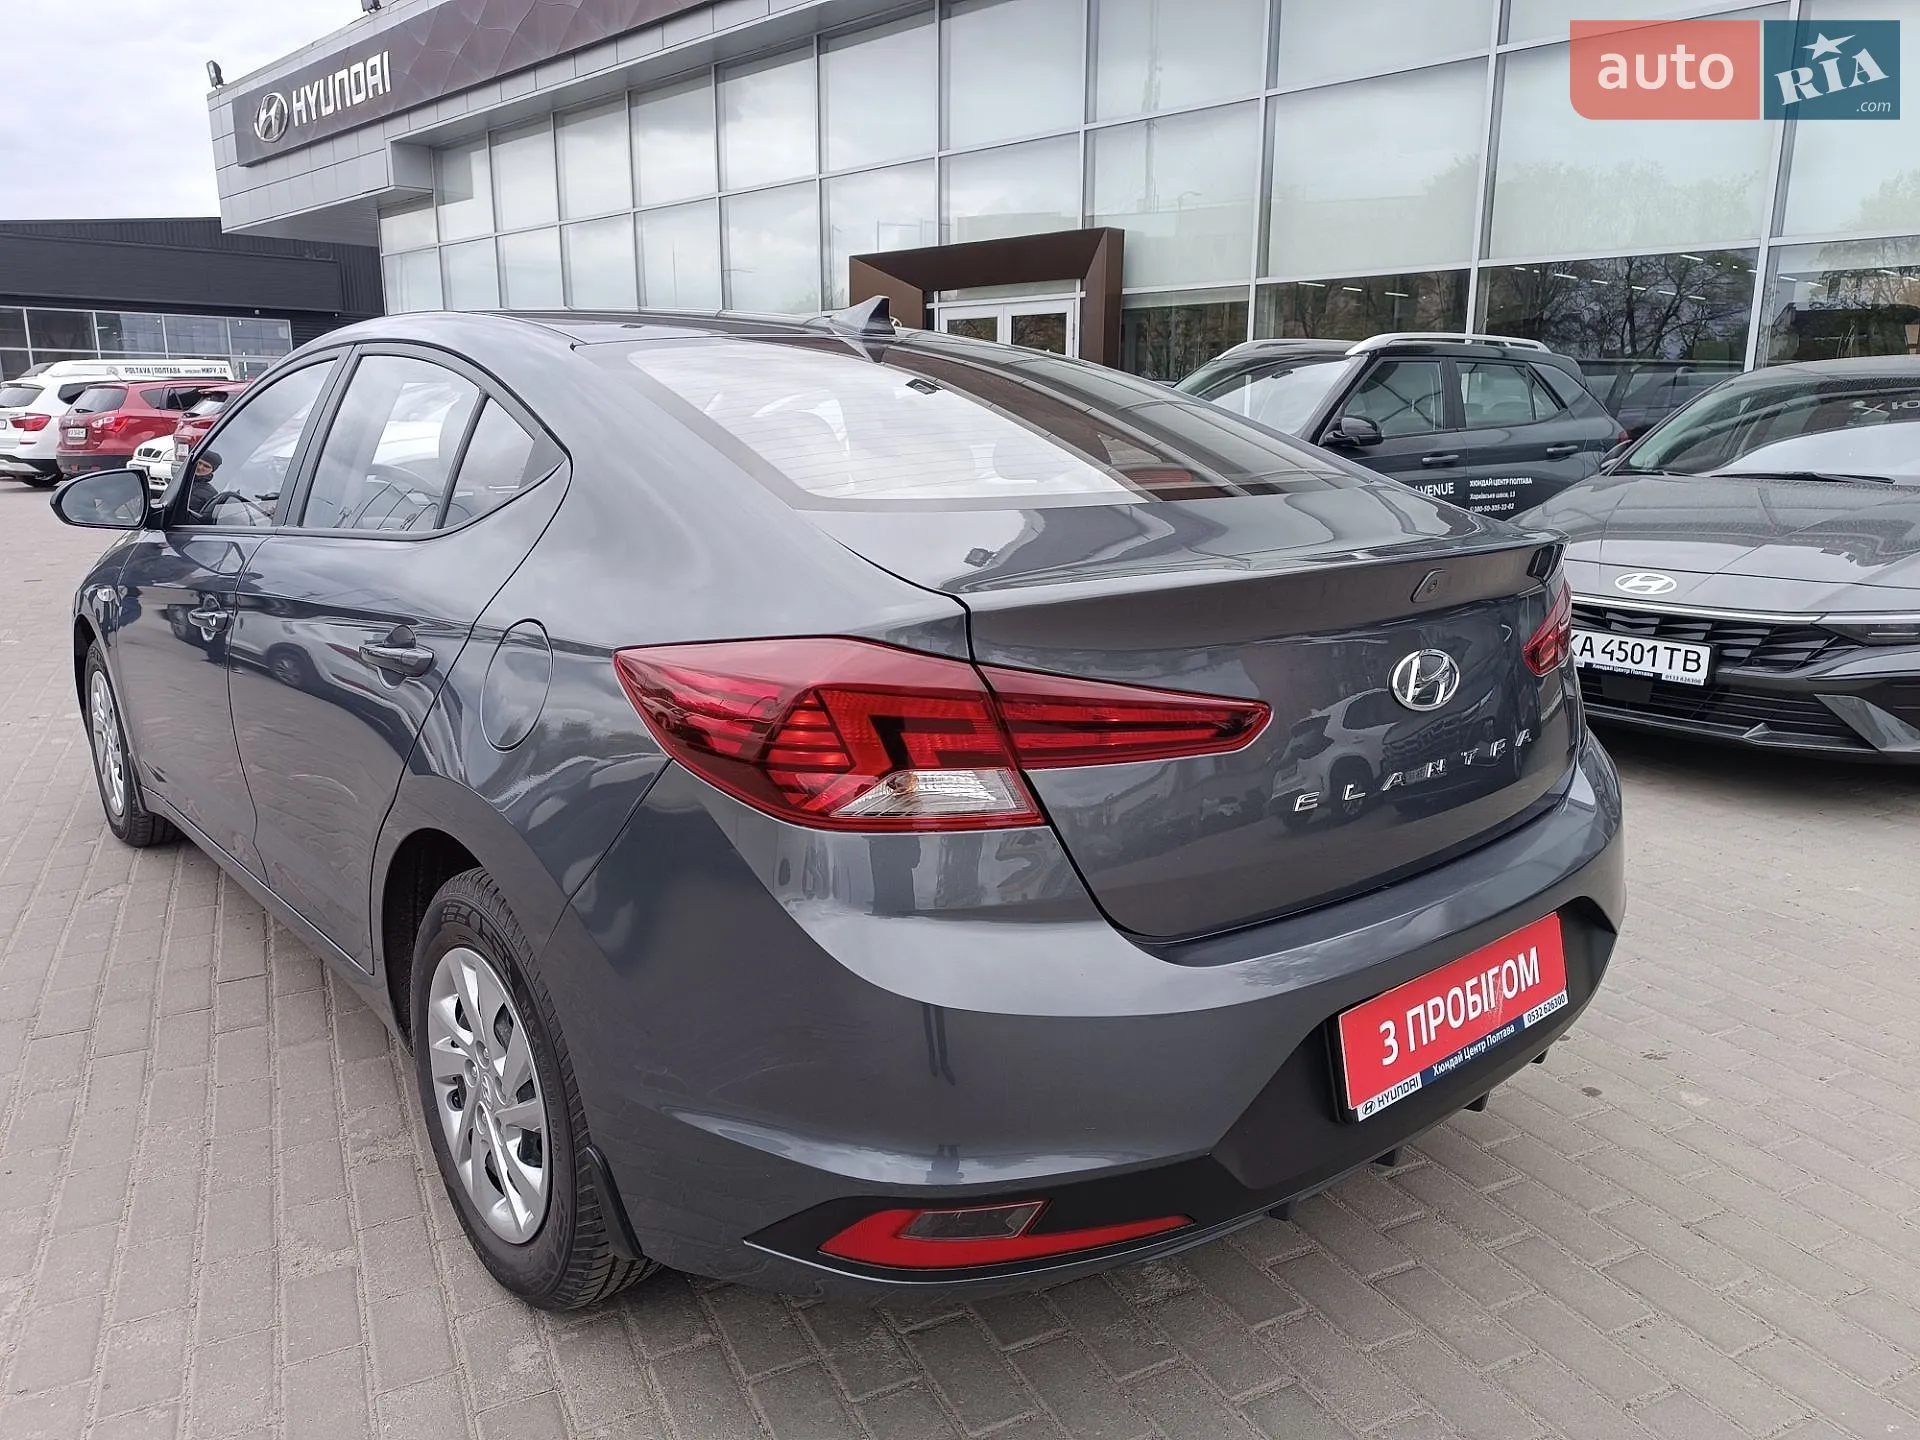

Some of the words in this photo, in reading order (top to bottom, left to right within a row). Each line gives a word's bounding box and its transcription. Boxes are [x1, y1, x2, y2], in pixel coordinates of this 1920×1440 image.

[293, 51, 391, 127] HYUNDAI
[1415, 482, 1454, 497] VENUE
[1509, 477, 1533, 485] ПОЛТАВА
[1601, 639, 1657, 668] 4501
[1664, 646, 1701, 673] TB
[1294, 728, 1532, 812] ELANTRA
[1405, 945, 1541, 1053] ПРОБІГОМ
[1527, 1007, 1544, 1024] 0532
[1432, 1052, 1464, 1077] Хюндай
[1463, 1040, 1487, 1061] Центр
[1486, 1024, 1516, 1049] Полтава
[1377, 1076, 1420, 1108] HYUNDAI
